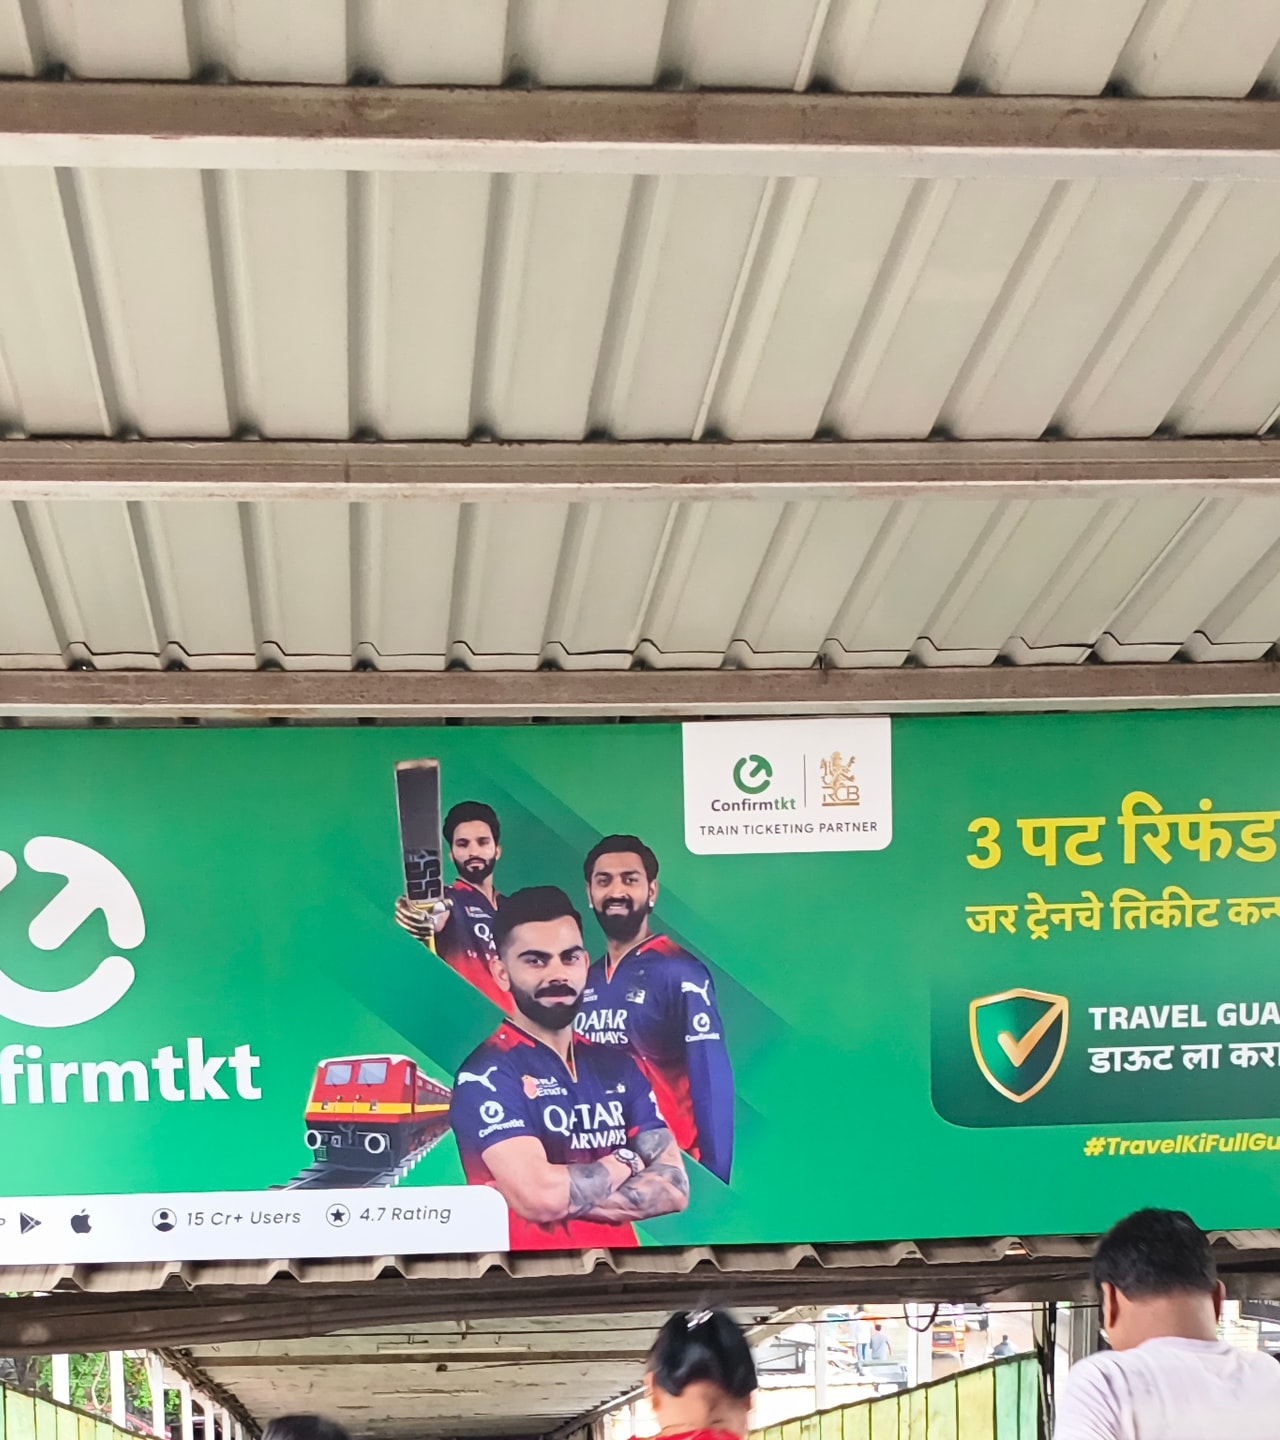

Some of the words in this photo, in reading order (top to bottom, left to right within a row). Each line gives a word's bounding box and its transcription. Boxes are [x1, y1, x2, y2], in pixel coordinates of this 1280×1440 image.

[711, 796, 796, 812] Confirmtkt
[821, 785, 860, 803] RCB
[700, 825, 739, 836] TRAIN
[743, 823, 815, 835] TICKETING
[819, 821, 878, 833] PARTNER
[966, 816, 1002, 870] 3
[1016, 816, 1107, 867] पट
[966, 904, 1019, 935] जर
[1024, 890, 1104, 940] ट्रेनचे
[1110, 885, 1220, 931] तिकीट
[1088, 1004, 1208, 1031] TRAVEL
[1087, 1045, 1175, 1074] डाऊट
[1180, 1043, 1223, 1070] ला
[188, 1211, 204, 1226] 15
[210, 1211, 243, 1226] Cr+
[250, 1211, 301, 1225] Users
[359, 1207, 387, 1222] 4.7
[391, 1205, 452, 1225] Rating
